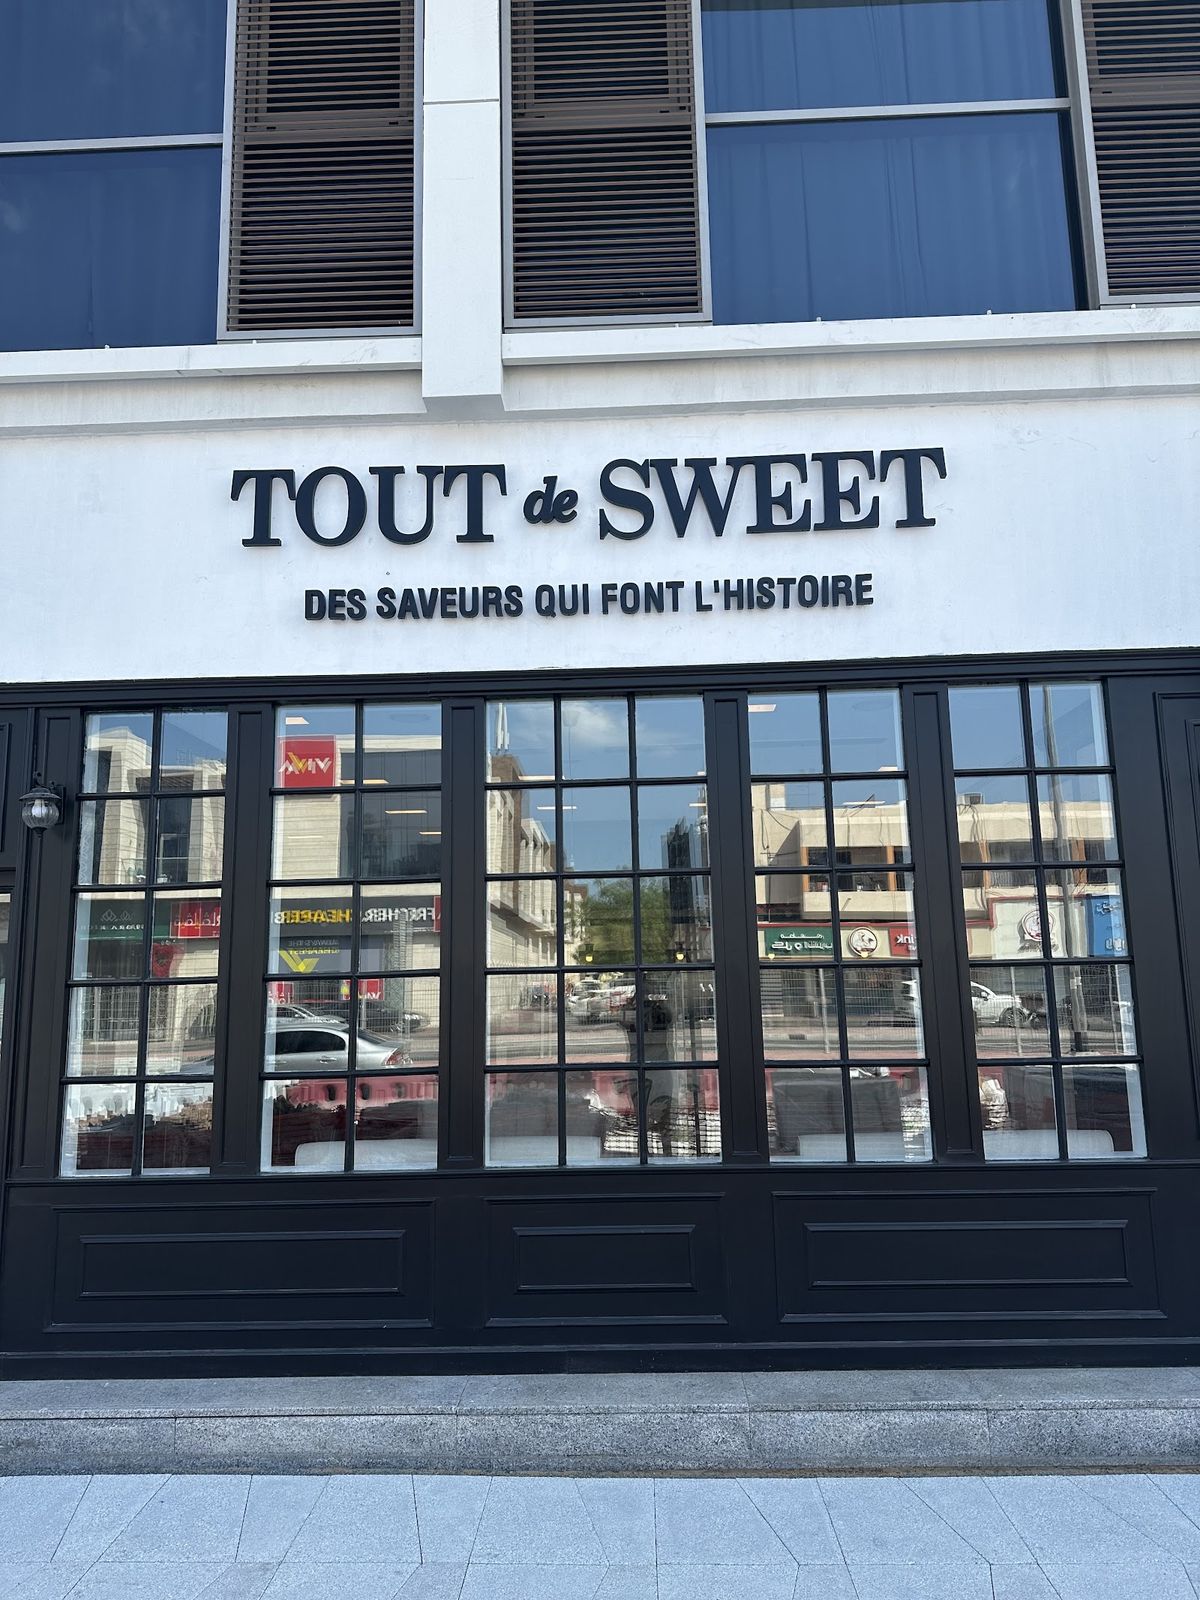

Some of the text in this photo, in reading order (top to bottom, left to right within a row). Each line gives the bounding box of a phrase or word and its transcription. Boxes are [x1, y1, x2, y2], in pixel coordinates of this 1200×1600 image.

[230, 447, 948, 548] TOUT de SWEET
[305, 573, 874, 622] DES SAVEURS QUI FONT L'HISTOIRE
